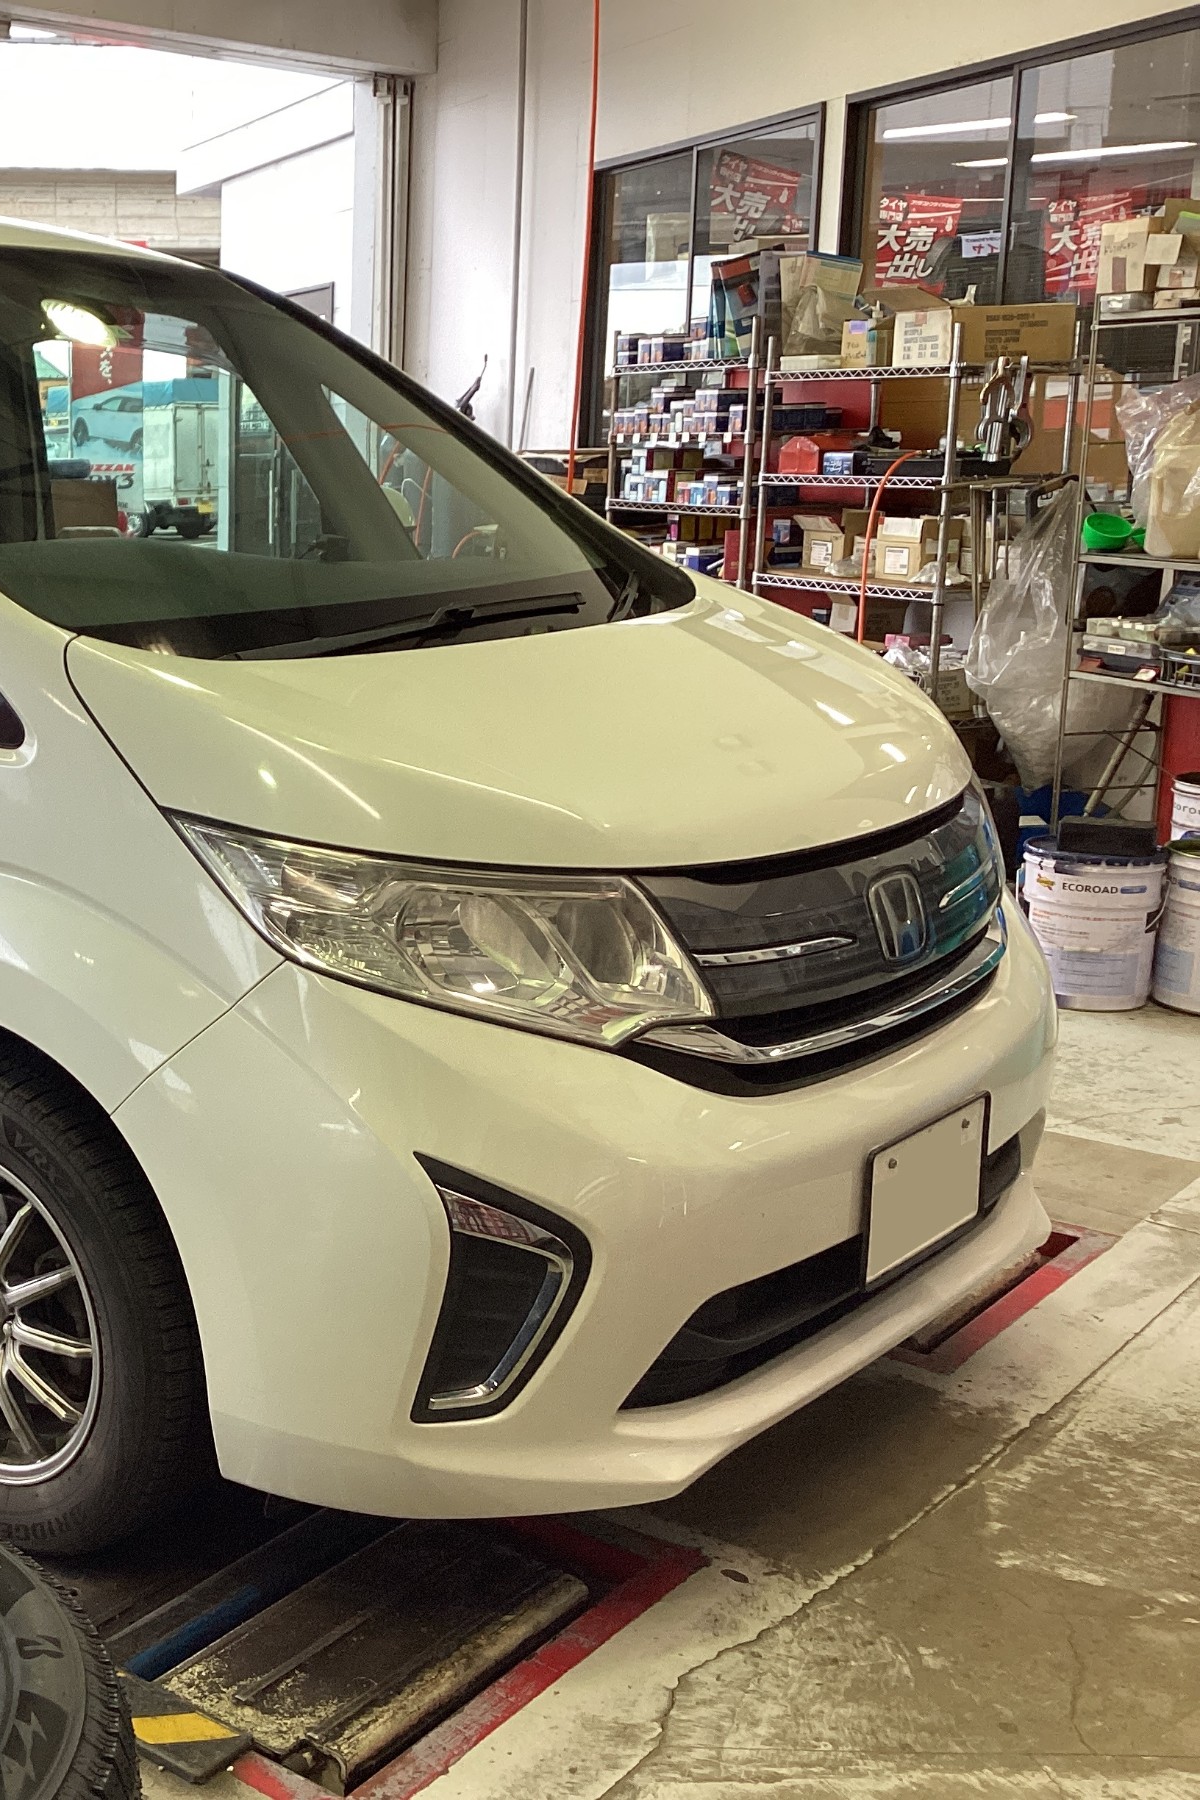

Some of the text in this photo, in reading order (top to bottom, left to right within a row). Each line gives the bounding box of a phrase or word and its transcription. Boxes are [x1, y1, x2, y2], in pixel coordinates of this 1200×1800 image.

[880, 197, 907, 211] タイヤ
[1048, 200, 1077, 212] タイヤ
[877, 224, 937, 252] 大売
[886, 253, 933, 278] 出し
[1062, 882, 1118, 894] ECOROAD
